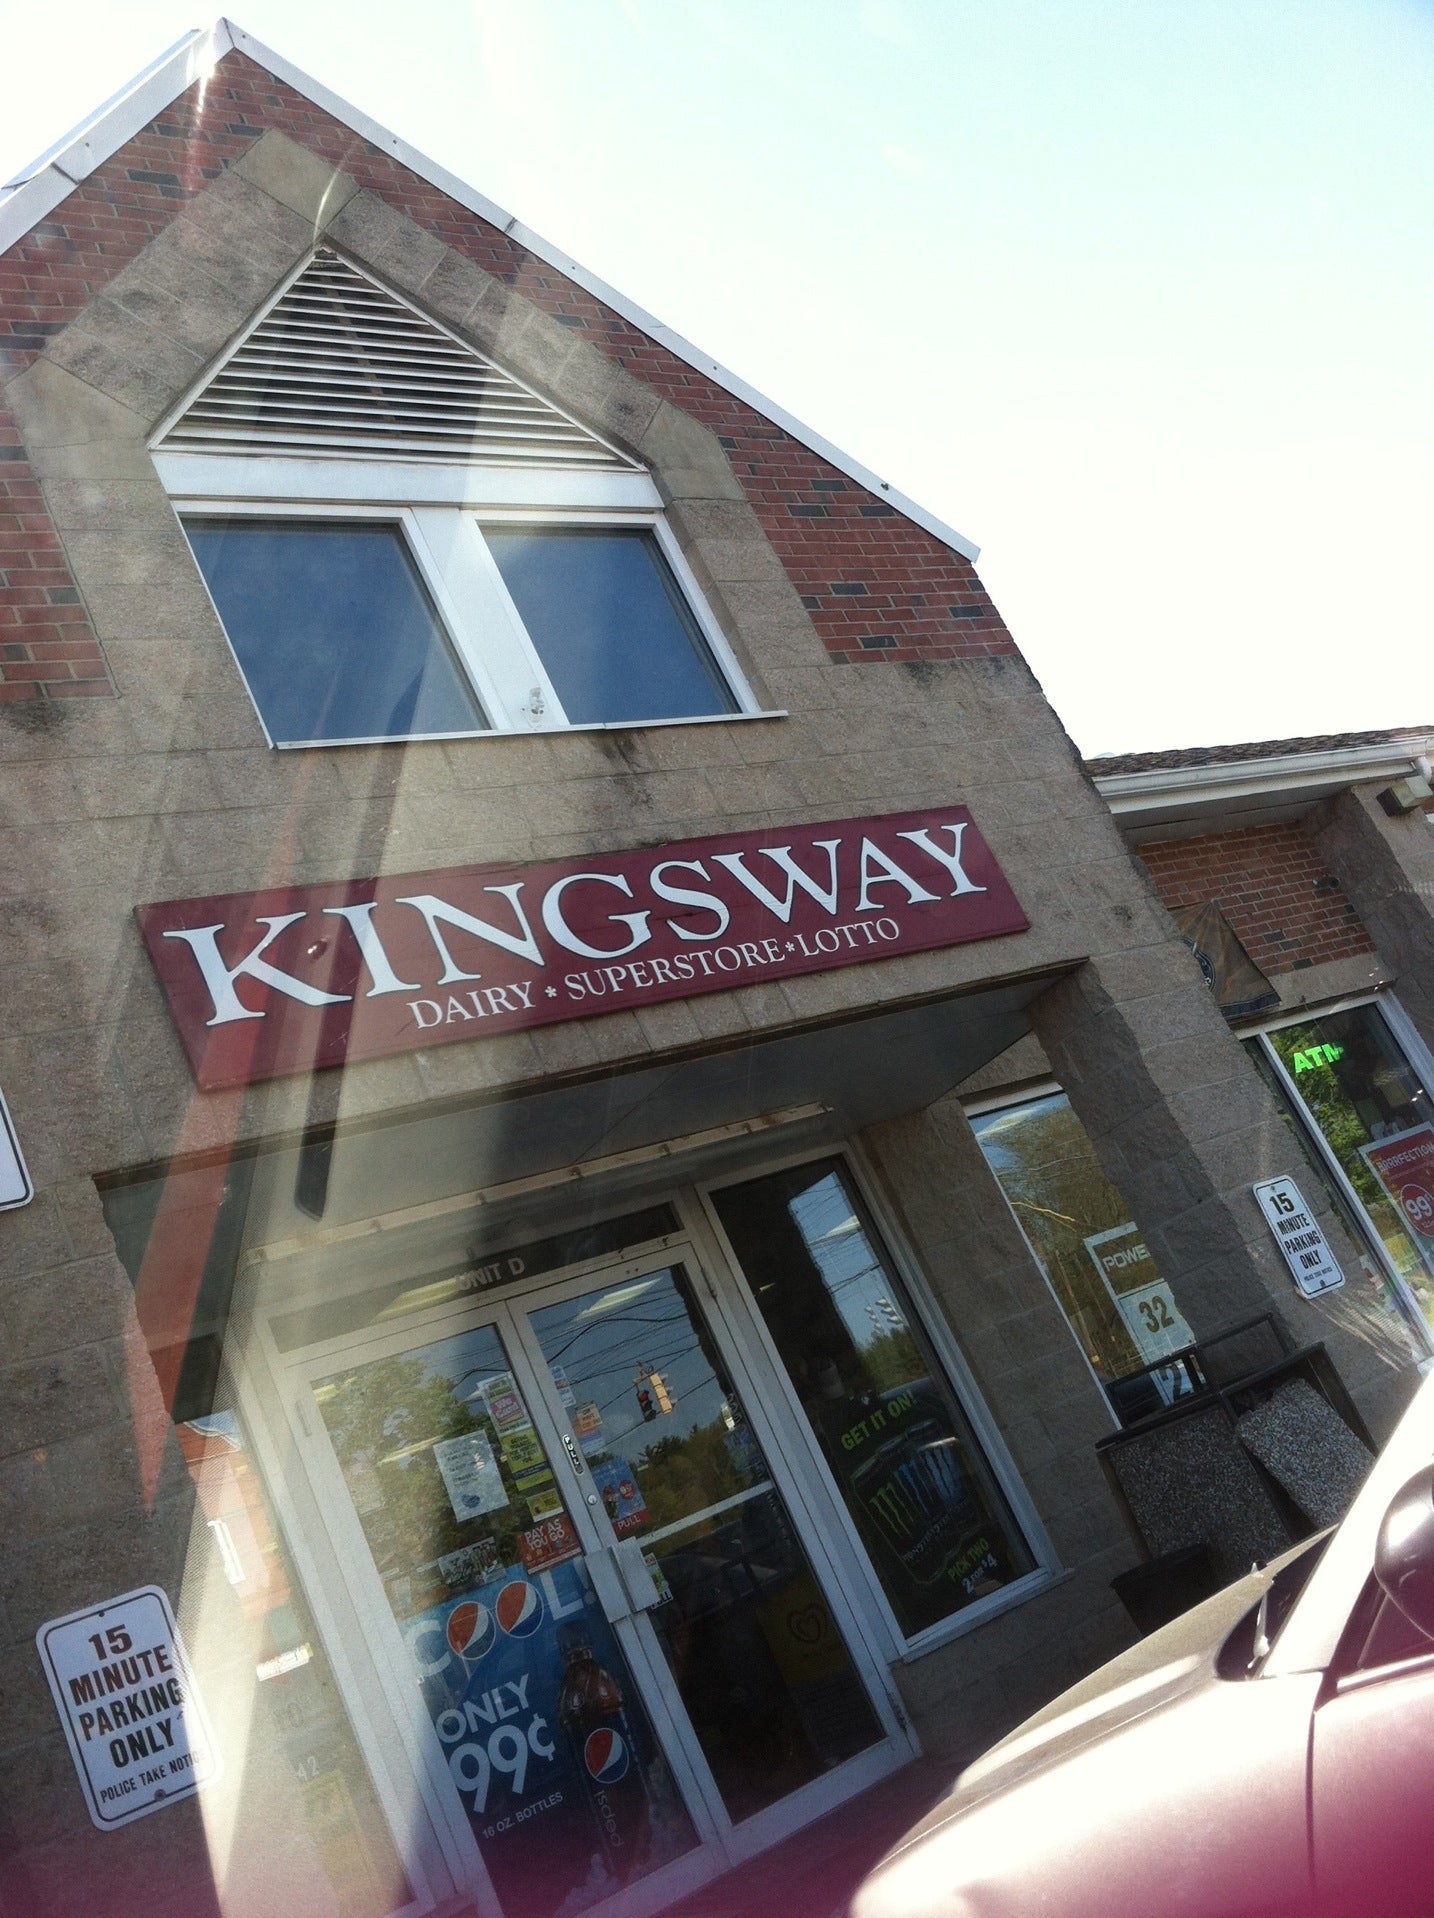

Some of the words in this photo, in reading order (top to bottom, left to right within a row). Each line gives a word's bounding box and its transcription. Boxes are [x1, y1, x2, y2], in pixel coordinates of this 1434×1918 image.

[162, 820, 988, 1027] KINGSWAY
[408, 980, 537, 1031] DAIRY
[563, 935, 787, 1003] SUPERSTORE
[792, 916, 901, 958] LOTTO
[1269, 1192, 1295, 1215] 15
[1276, 1212, 1310, 1236] MINUTE
[1284, 1230, 1321, 1255] PARKING
[508, 1257, 525, 1276] D
[1299, 1251, 1321, 1270] ONLY
[1138, 1295, 1175, 1333] 32
[841, 1420, 870, 1450] GET
[869, 1408, 887, 1430] IT
[887, 1390, 918, 1417] ON!
[524, 1525, 546, 1545] PAY
[547, 1518, 563, 1534] AS
[528, 1535, 549, 1551] YOU
[549, 1529, 565, 1542] GO
[617, 1516, 642, 1531] PULL
[88, 1624, 133, 1661] 15
[68, 1644, 173, 1707] MINUTE
[78, 1677, 187, 1741] PARKING
[435, 1673, 529, 1743] ONLY
[109, 1718, 175, 1769] ONLY
[449, 1713, 556, 1814] 99¢
[100, 1779, 136, 1803] POLICE
[139, 1765, 167, 1787] TAKE
[482, 1824, 495, 1839] 16
[516, 1791, 564, 1823] BOTTLES
